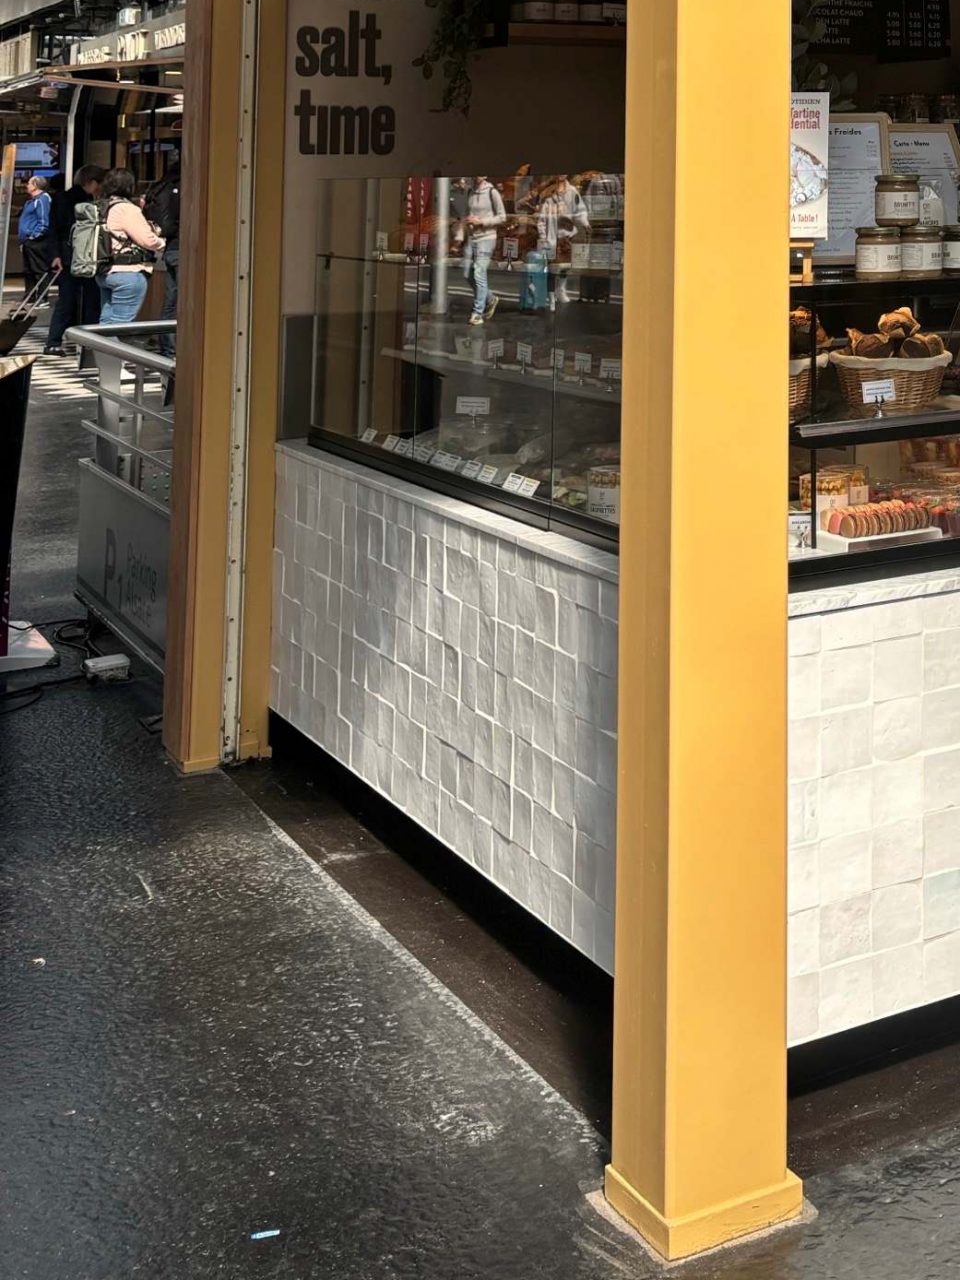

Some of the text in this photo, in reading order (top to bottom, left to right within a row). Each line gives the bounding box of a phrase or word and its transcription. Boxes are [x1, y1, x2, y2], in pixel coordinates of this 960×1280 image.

[295, 10, 392, 85] salt,
[294, 89, 396, 156] time
[126, 541, 158, 602] Parking
